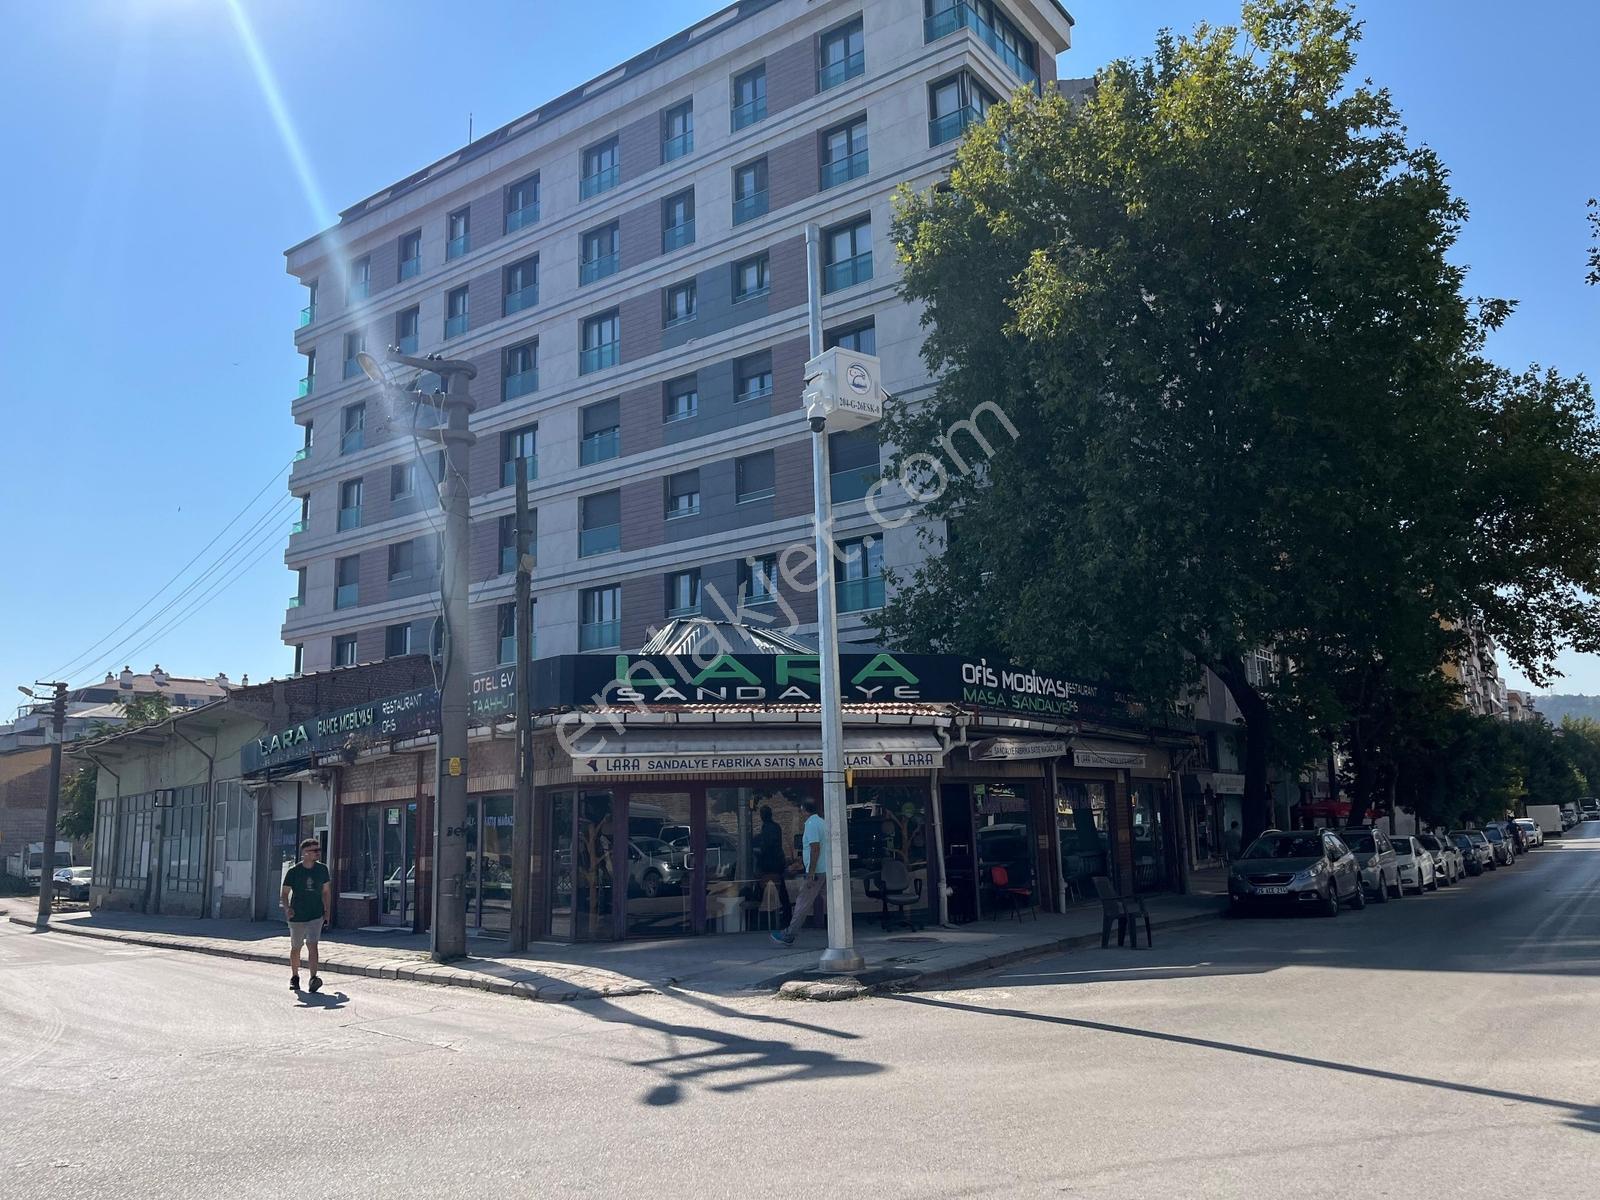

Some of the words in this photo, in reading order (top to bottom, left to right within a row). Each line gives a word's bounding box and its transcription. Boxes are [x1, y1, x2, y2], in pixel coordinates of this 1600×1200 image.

[615, 654, 920, 686] LARA
[473, 676, 498, 694] OTEL
[500, 671, 514, 688] EV
[616, 686, 920, 701] SANDAYE
[382, 693, 423, 715] RESTAURANT
[963, 687, 1007, 706] MASA
[258, 724, 309, 757] LARA
[606, 758, 640, 771] LARA
[648, 759, 709, 770] SANDALYE
[712, 756, 762, 768] FABRİKA
[764, 757, 796, 769] SATIŞ
[901, 753, 934, 766] LARA
